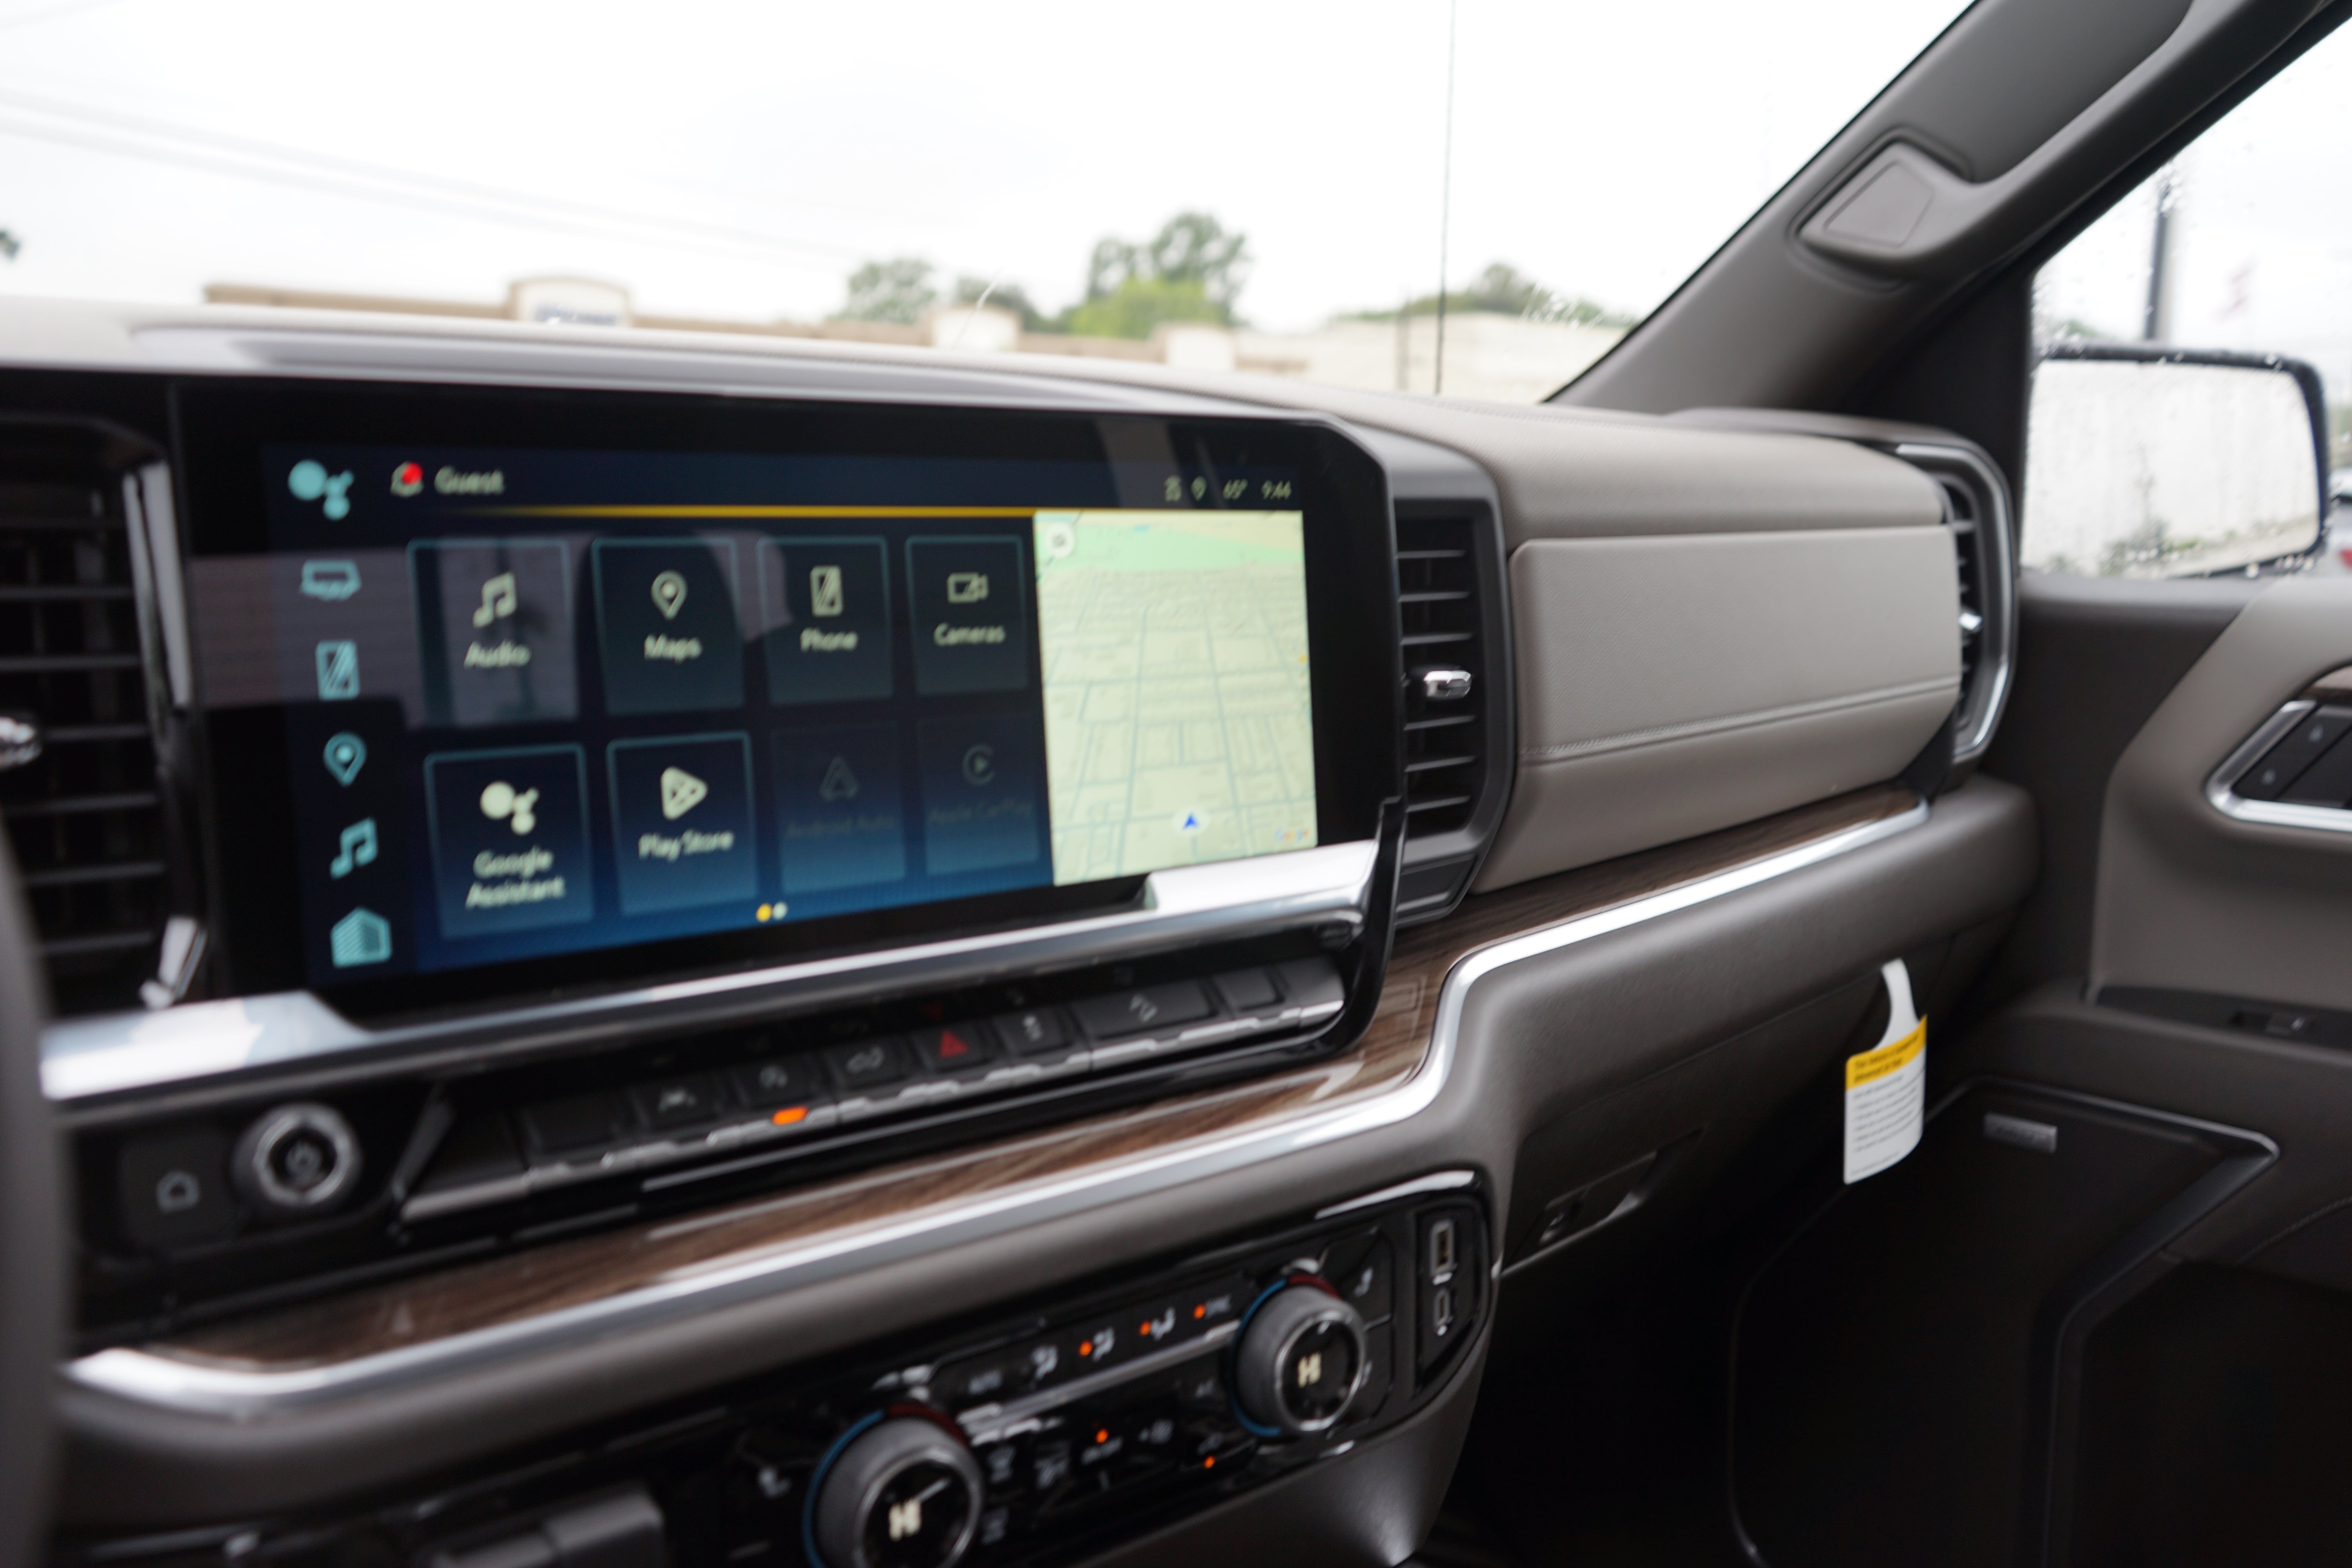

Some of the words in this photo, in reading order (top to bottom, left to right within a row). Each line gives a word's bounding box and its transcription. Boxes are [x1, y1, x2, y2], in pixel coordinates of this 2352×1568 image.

[434, 466, 504, 494] Guest
[644, 634, 702, 662] Maps
[800, 627, 858, 652] Phone
[933, 622, 1006, 646] Cameras
[464, 640, 531, 668] Audio
[639, 832, 681, 861] Play
[680, 829, 735, 855] Store
[473, 845, 554, 879] Google
[465, 875, 566, 909] Assistant
